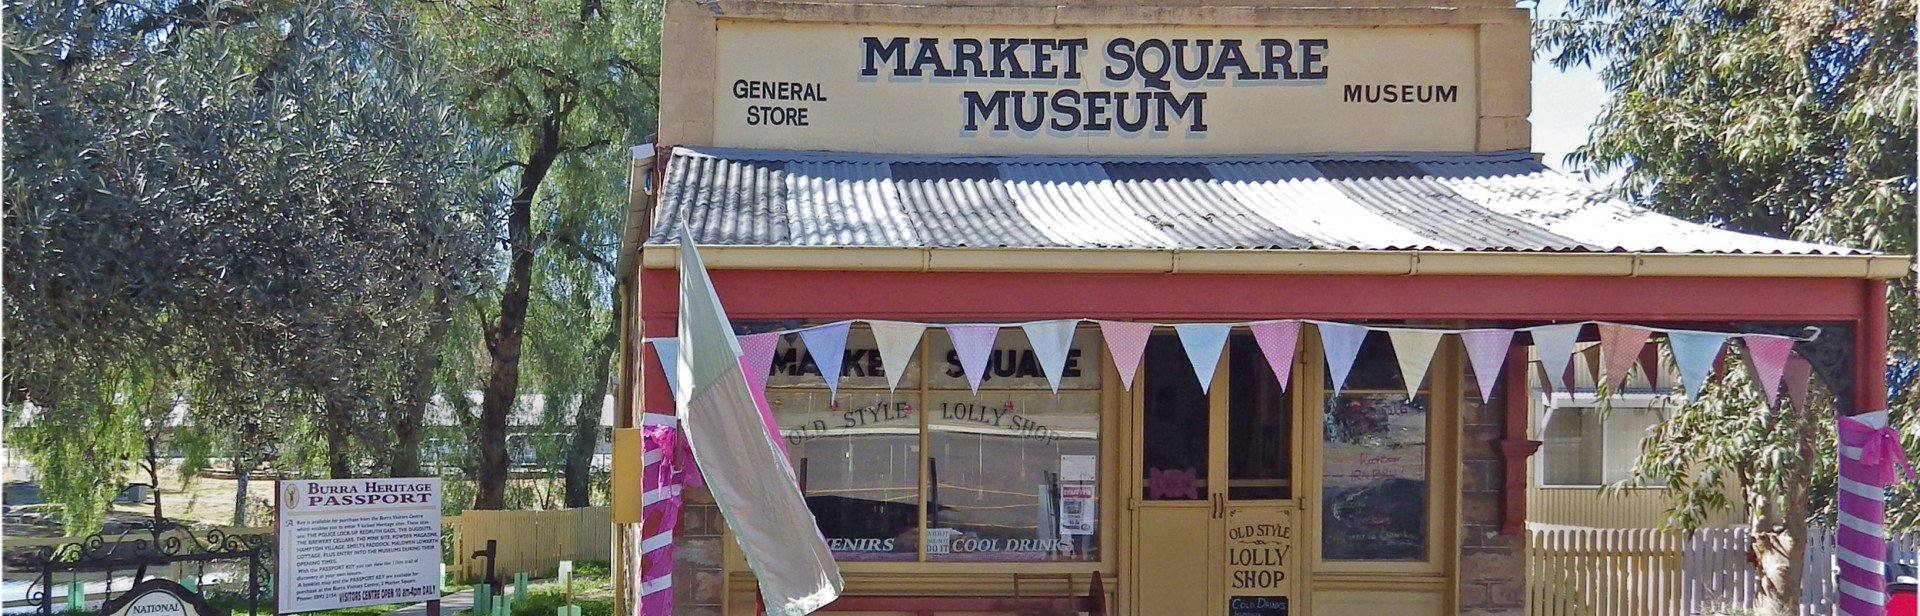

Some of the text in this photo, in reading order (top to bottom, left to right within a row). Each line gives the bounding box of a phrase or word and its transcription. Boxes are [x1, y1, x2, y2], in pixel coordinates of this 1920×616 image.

[861, 37, 1329, 90] MARKET SQUARE
[733, 79, 827, 101] GENERAL
[1343, 84, 1458, 103] MUSEUM
[747, 105, 809, 126] STORE
[963, 88, 1208, 132] MUSEUM
[769, 348, 1082, 381] MAKE SUAE
[789, 401, 1060, 446] OLD STYLE LOLLY SHOP
[307, 482, 432, 494] BURRA HERITAGE
[308, 493, 432, 506] PASSPORT
[1229, 523, 1291, 539] OLD STYLE
[952, 538, 1000, 552] COOL
[1230, 545, 1290, 566] LOLLY
[1232, 570, 1285, 588] SHOP
[339, 591, 361, 602] VISITORS
[362, 590, 380, 600] CENTRE
[381, 588, 394, 598] OPEN
[422, 585, 436, 595] DAILY
[133, 603, 180, 614] NATIONAL
